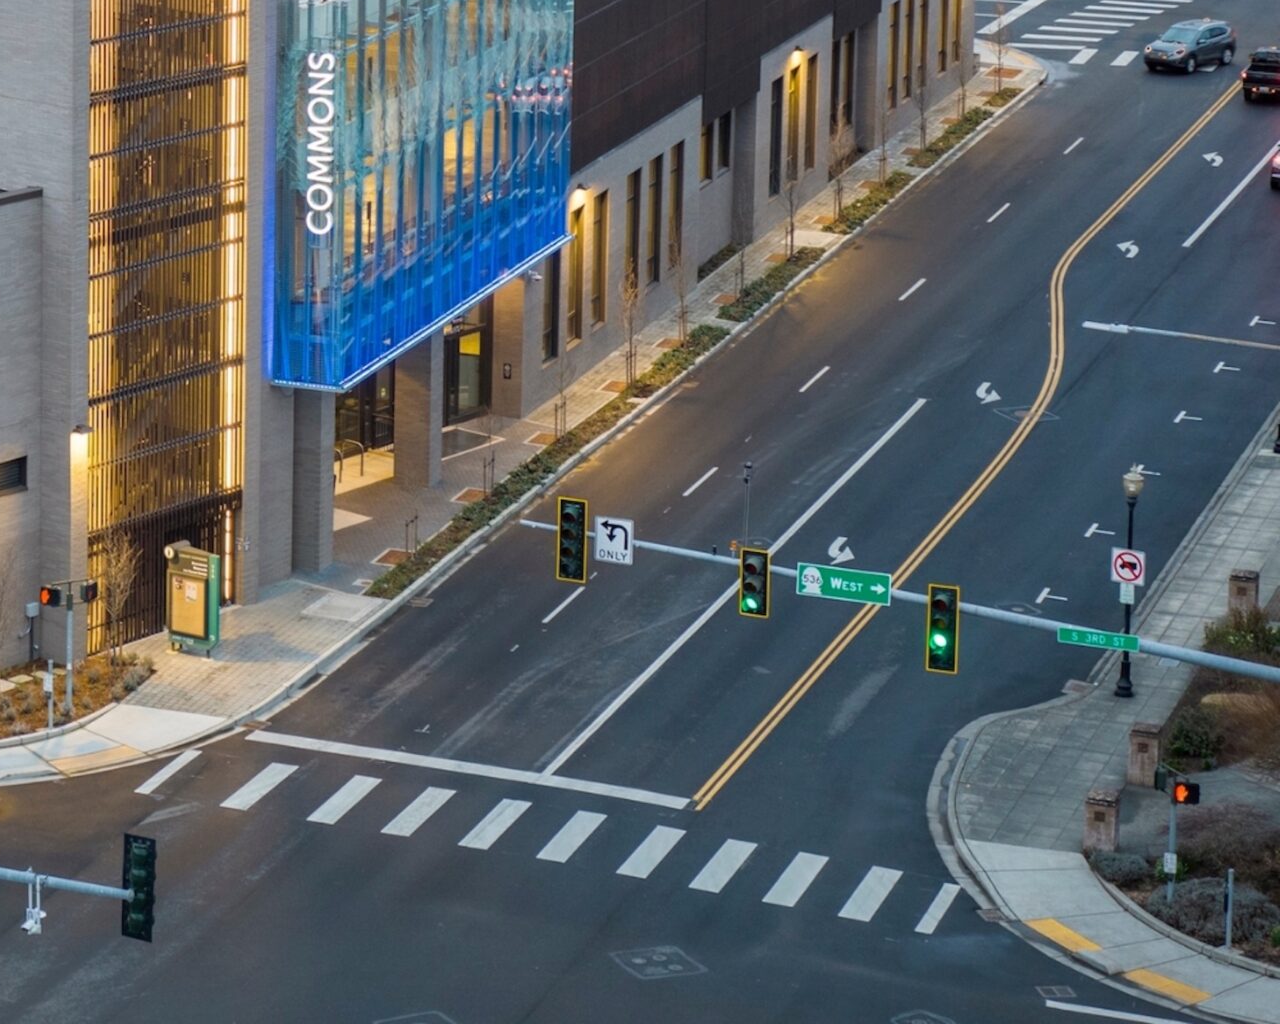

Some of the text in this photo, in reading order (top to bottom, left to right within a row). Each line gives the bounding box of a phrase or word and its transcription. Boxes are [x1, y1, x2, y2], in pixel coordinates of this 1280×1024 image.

[306, 52, 335, 234] COMMONS
[598, 549, 629, 562] ONLY
[804, 574, 822, 584] 536
[1071, 632, 1125, 647] S 3RD ST
